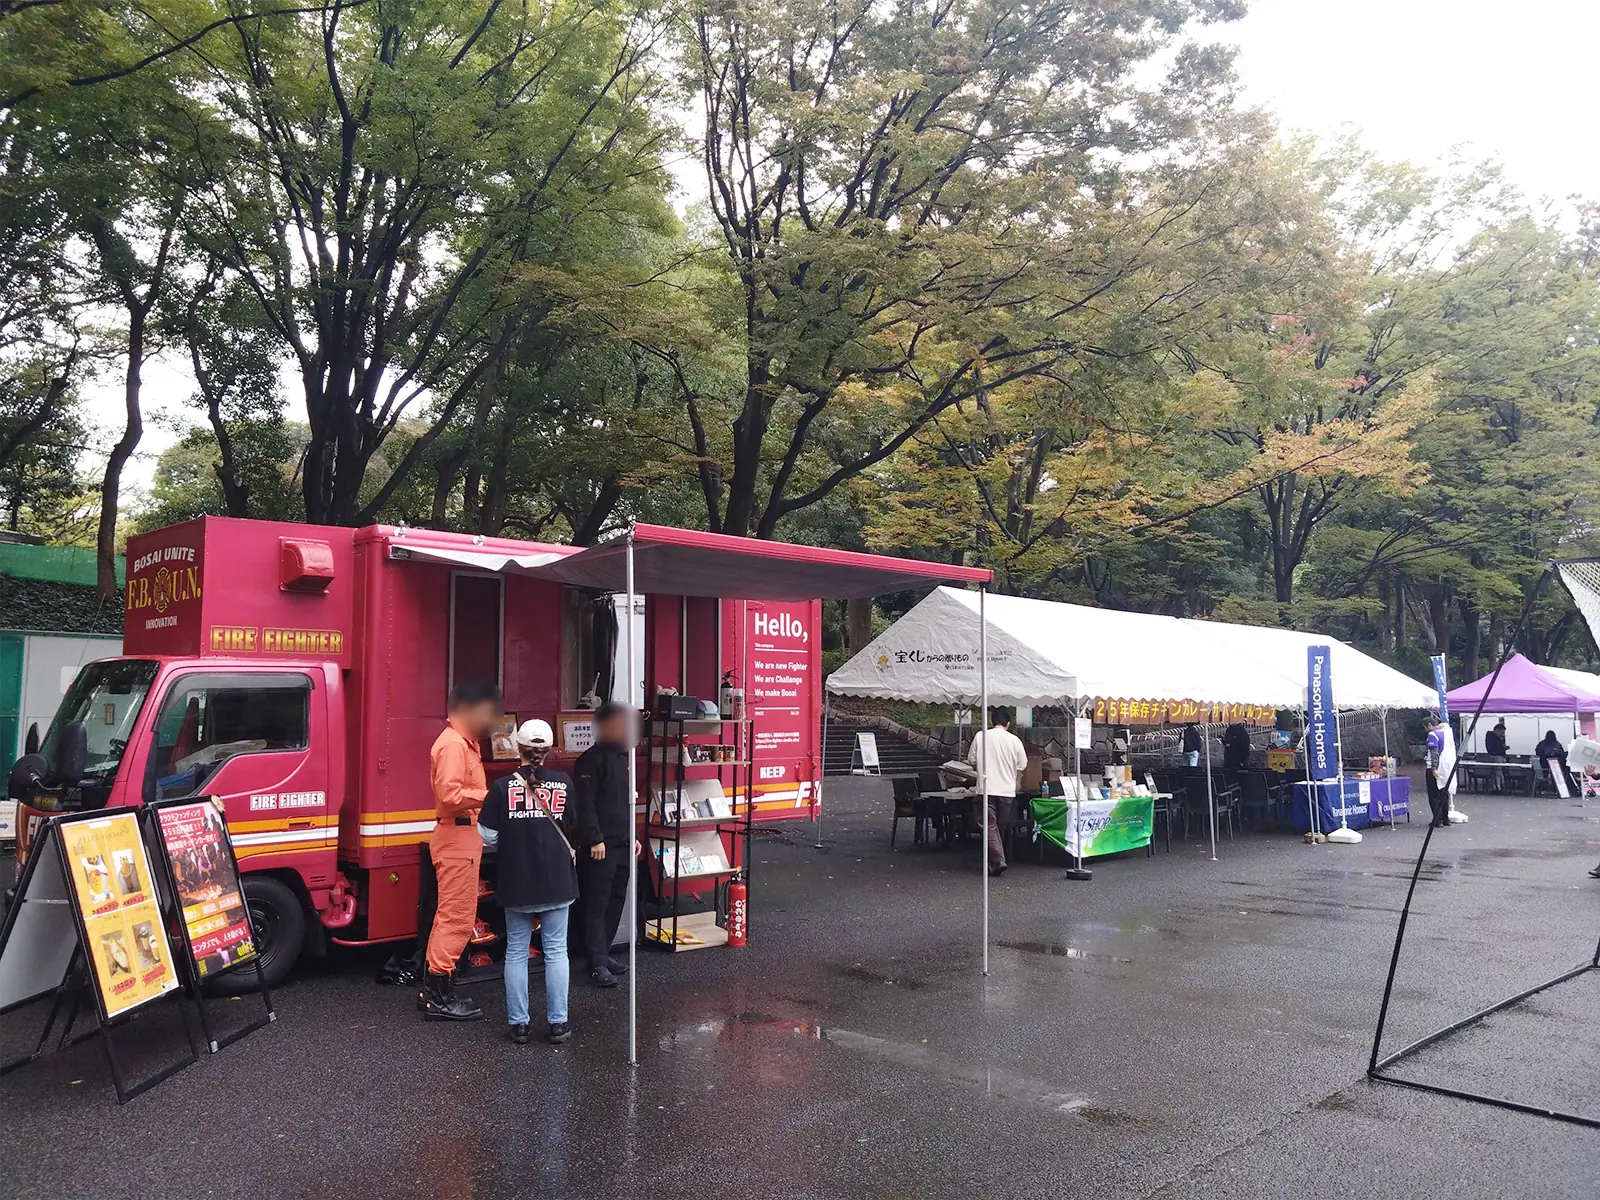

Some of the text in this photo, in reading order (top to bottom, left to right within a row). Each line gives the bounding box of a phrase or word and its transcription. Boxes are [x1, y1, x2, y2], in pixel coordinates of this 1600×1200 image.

[134, 546, 195, 573] BOSAI UNITE
[145, 615, 178, 630] INNOVATION
[754, 612, 808, 643] Hello,
[212, 626, 342, 653] FIRE FIGHTER
[754, 660, 764, 669] We
[788, 662, 808, 672] Fighter
[754, 674, 764, 683] We
[775, 675, 803, 685] Challenge
[754, 688, 797, 697] We make Bosai
[1312, 655, 1326, 769] Panasonic Homes
[760, 766, 786, 779] KEEP
[250, 792, 325, 810] FIRE FIGHTER
[508, 786, 567, 813] FIRE
[1086, 816, 1111, 832] SHOP
